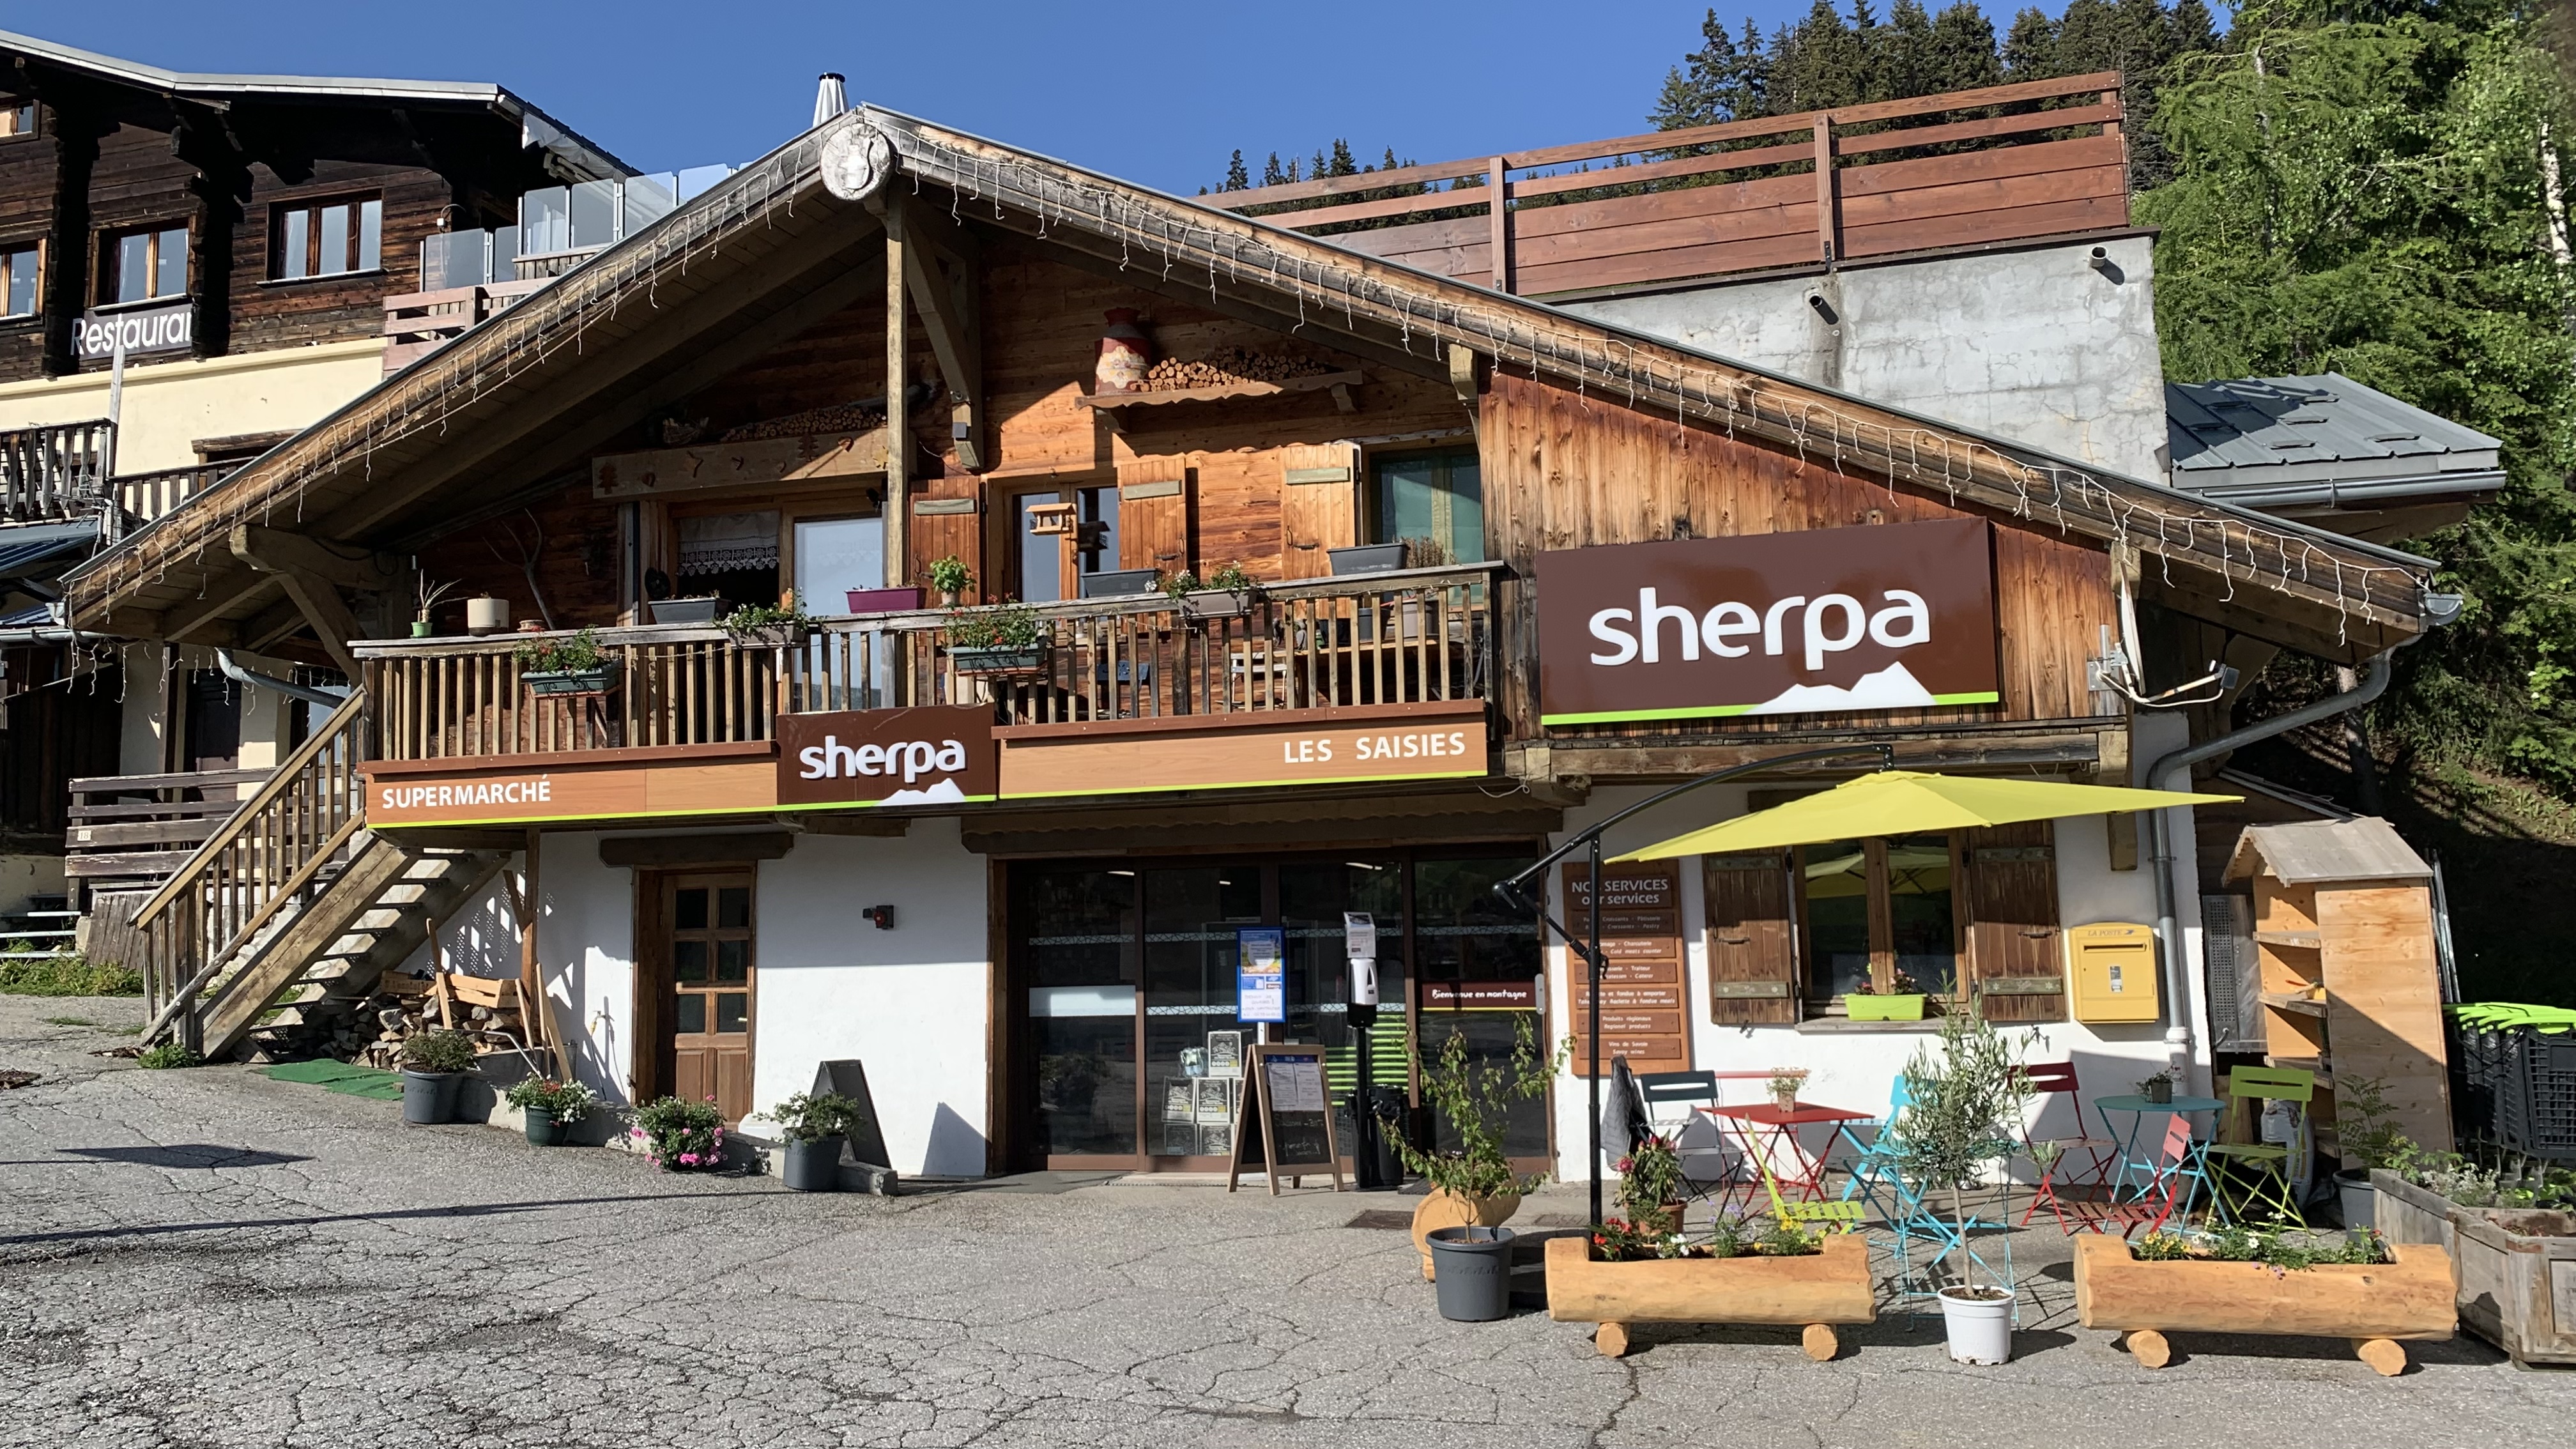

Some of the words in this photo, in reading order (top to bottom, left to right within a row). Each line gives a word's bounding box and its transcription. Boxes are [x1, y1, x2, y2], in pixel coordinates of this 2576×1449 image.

[70, 312, 191, 355] Restaura
[1589, 586, 1931, 671] sherpa
[799, 735, 965, 783] sherpa
[1284, 739, 1333, 763] LES
[1356, 732, 1466, 760] SAISIES
[382, 774, 551, 809] SUPERMARCHÉ
[1582, 896, 1604, 905] or
[1607, 893, 1660, 905] services
[1604, 878, 1668, 892] SERVICES
[1432, 989, 1473, 999] Bienvenue
[1487, 989, 1527, 1000] montagne
